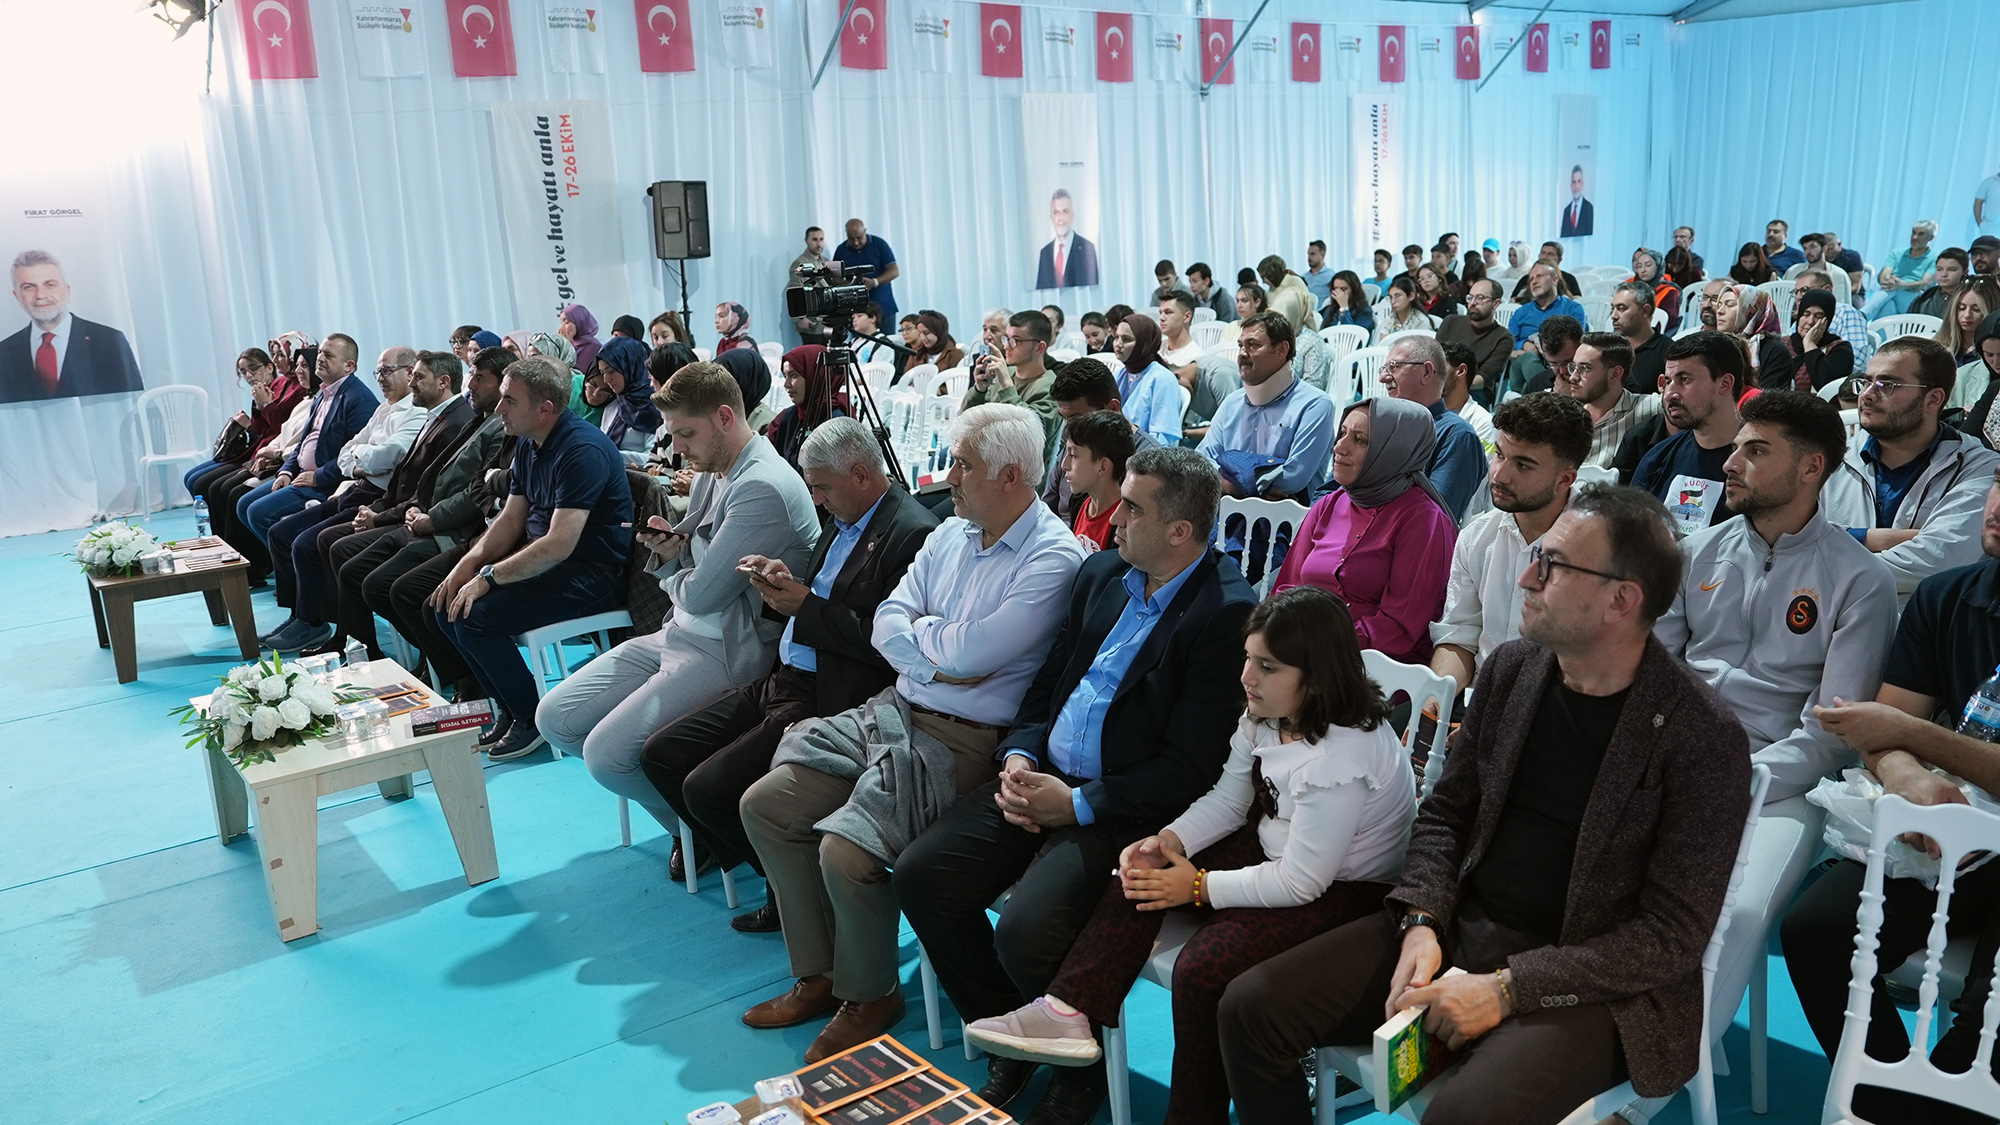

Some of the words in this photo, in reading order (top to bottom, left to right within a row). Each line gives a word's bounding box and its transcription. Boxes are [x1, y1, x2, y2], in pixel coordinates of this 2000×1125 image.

[356, 15, 402, 24] Kahramanmaraş
[1371, 104, 1379, 138] anla
[533, 115, 554, 167] anla
[563, 155, 580, 198] 17-26
[542, 171, 564, 241] hayatı
[554, 244, 567, 264] ve
